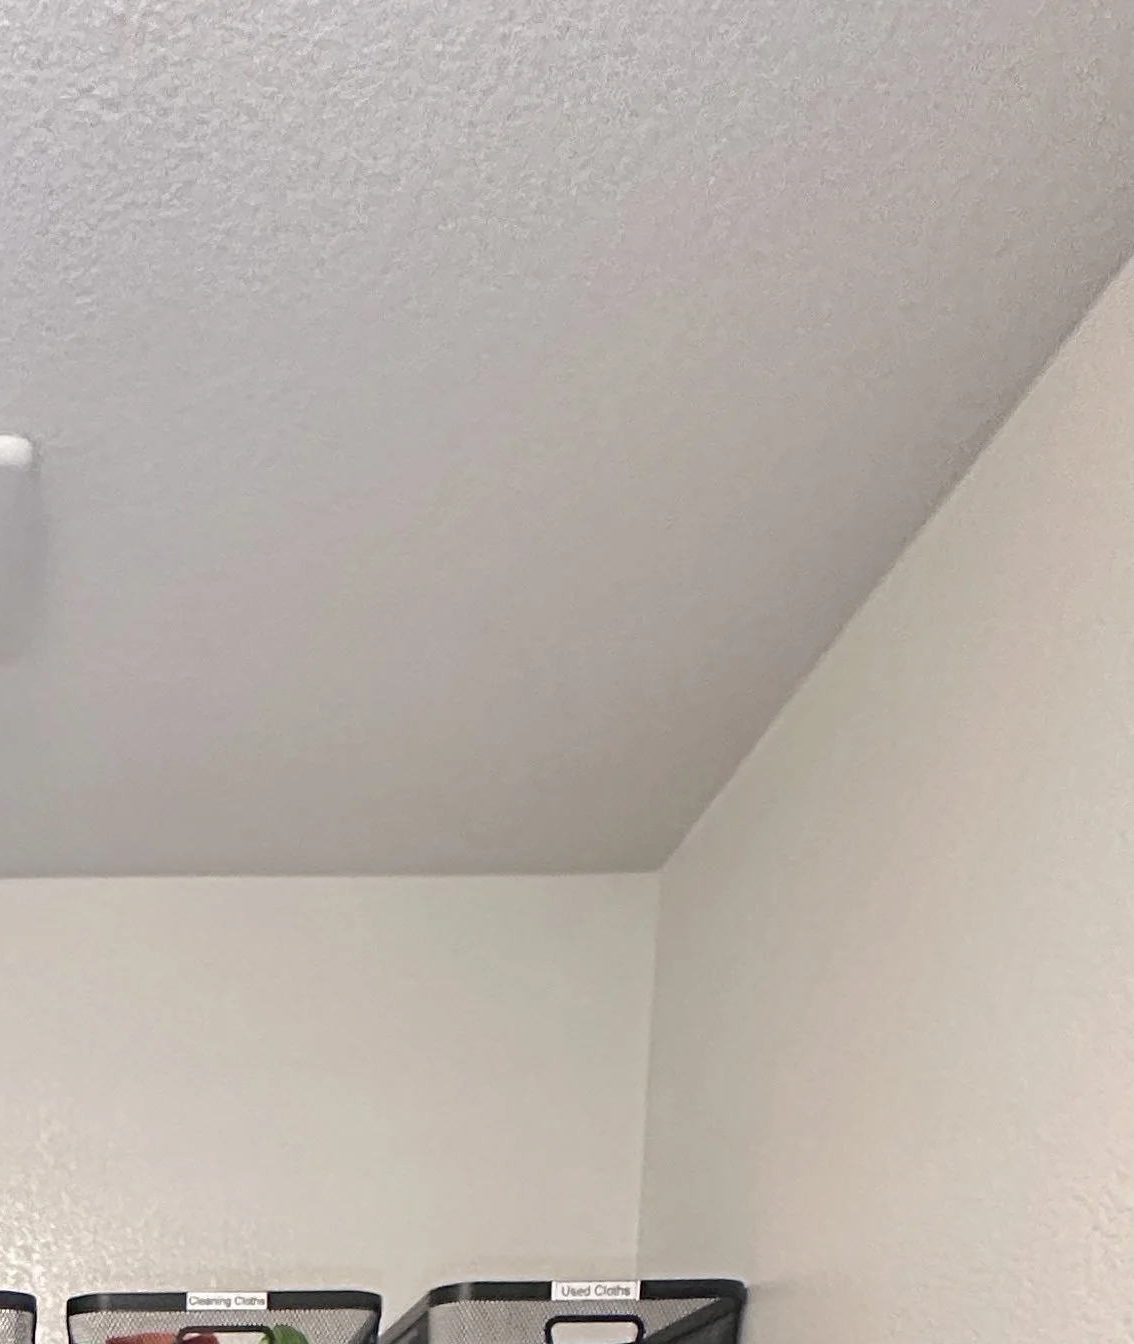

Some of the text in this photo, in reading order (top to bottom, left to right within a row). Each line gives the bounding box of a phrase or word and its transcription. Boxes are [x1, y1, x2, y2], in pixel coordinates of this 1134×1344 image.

[561, 1284, 631, 1297] Used Cloths
[189, 1296, 232, 1308] Cleaning
